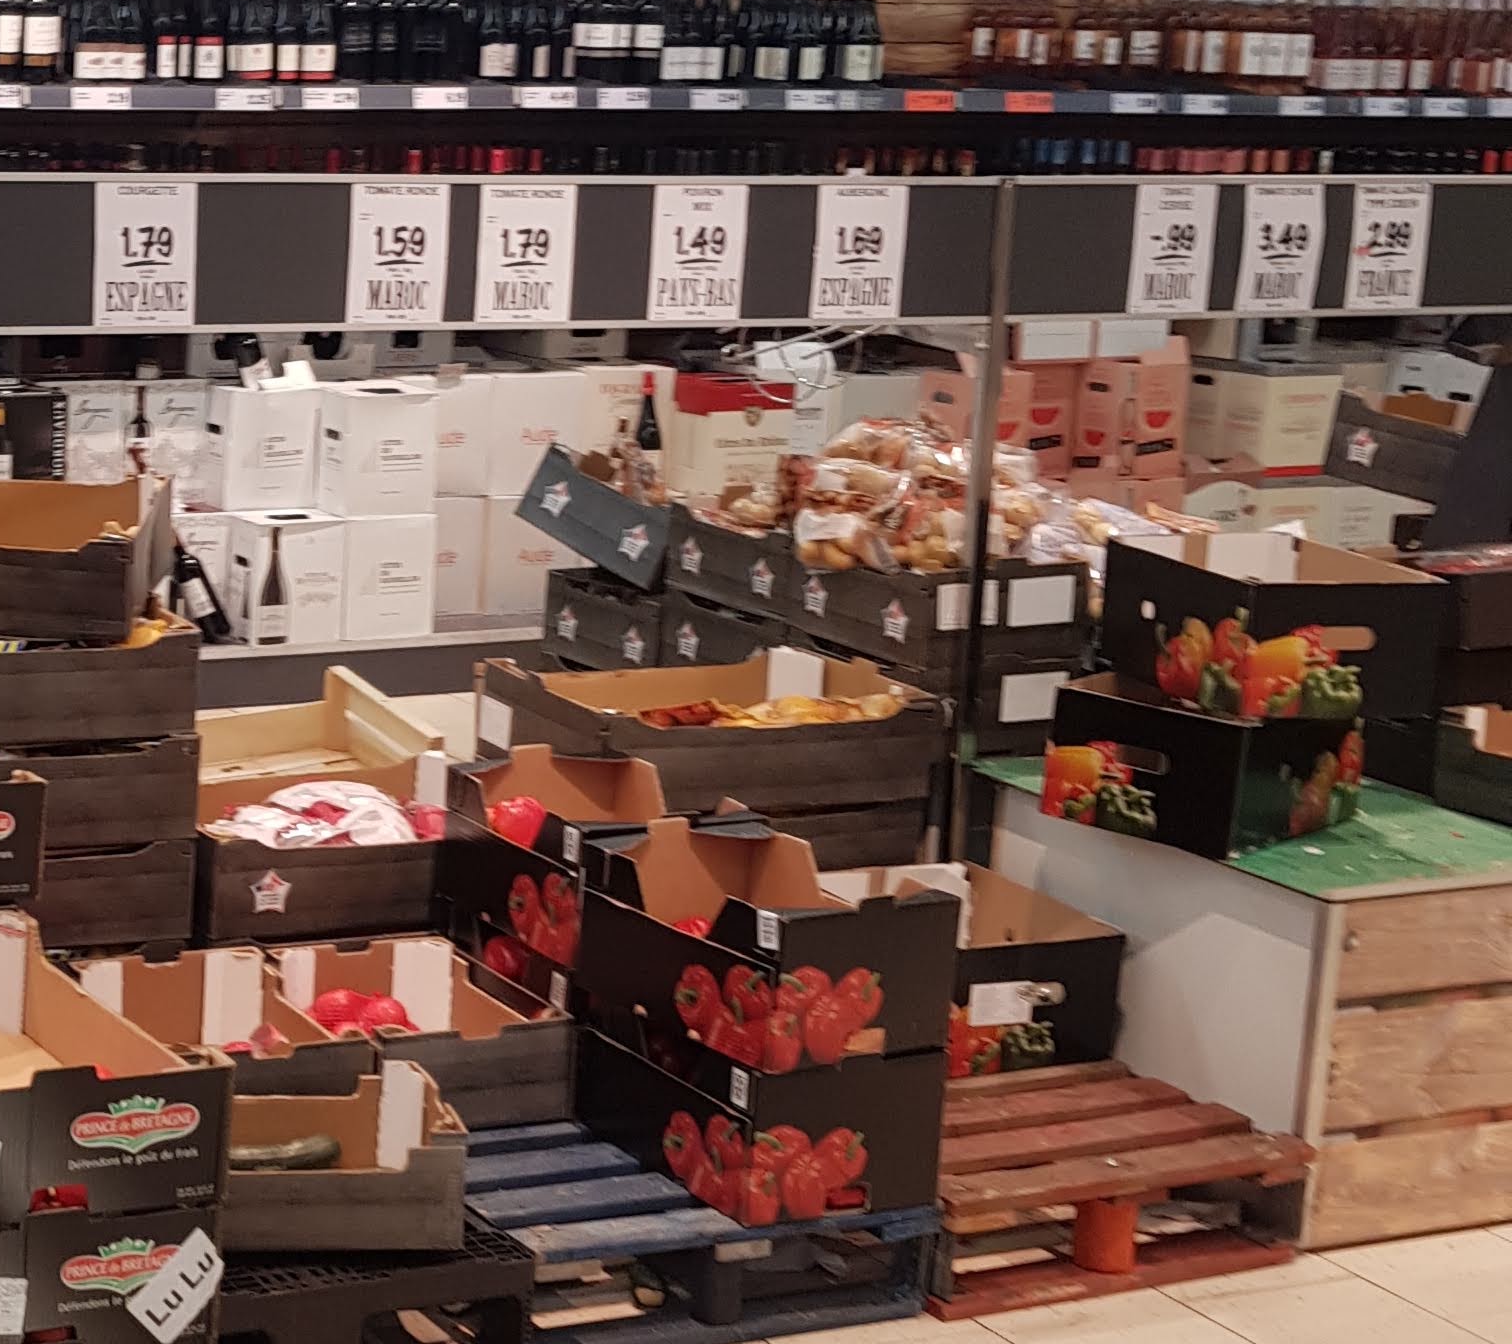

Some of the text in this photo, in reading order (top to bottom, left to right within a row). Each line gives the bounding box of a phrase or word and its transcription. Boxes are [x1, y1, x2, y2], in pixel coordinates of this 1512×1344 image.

[120, 226, 174, 258] 1.79
[374, 225, 426, 258] 1.59
[501, 228, 551, 259] 1.79
[673, 225, 727, 256] 1.49
[104, 281, 189, 312] ESPAGNE
[365, 279, 430, 311] MAROC
[492, 281, 554, 311] MAROC
[656, 277, 737, 307] PAYS-BAS
[817, 276, 893, 307] ESPAGNE
[75, 1119, 118, 1136] PRINCE
[131, 1111, 191, 1129] BRETAGNE
[65, 1261, 106, 1279] PRINCE
